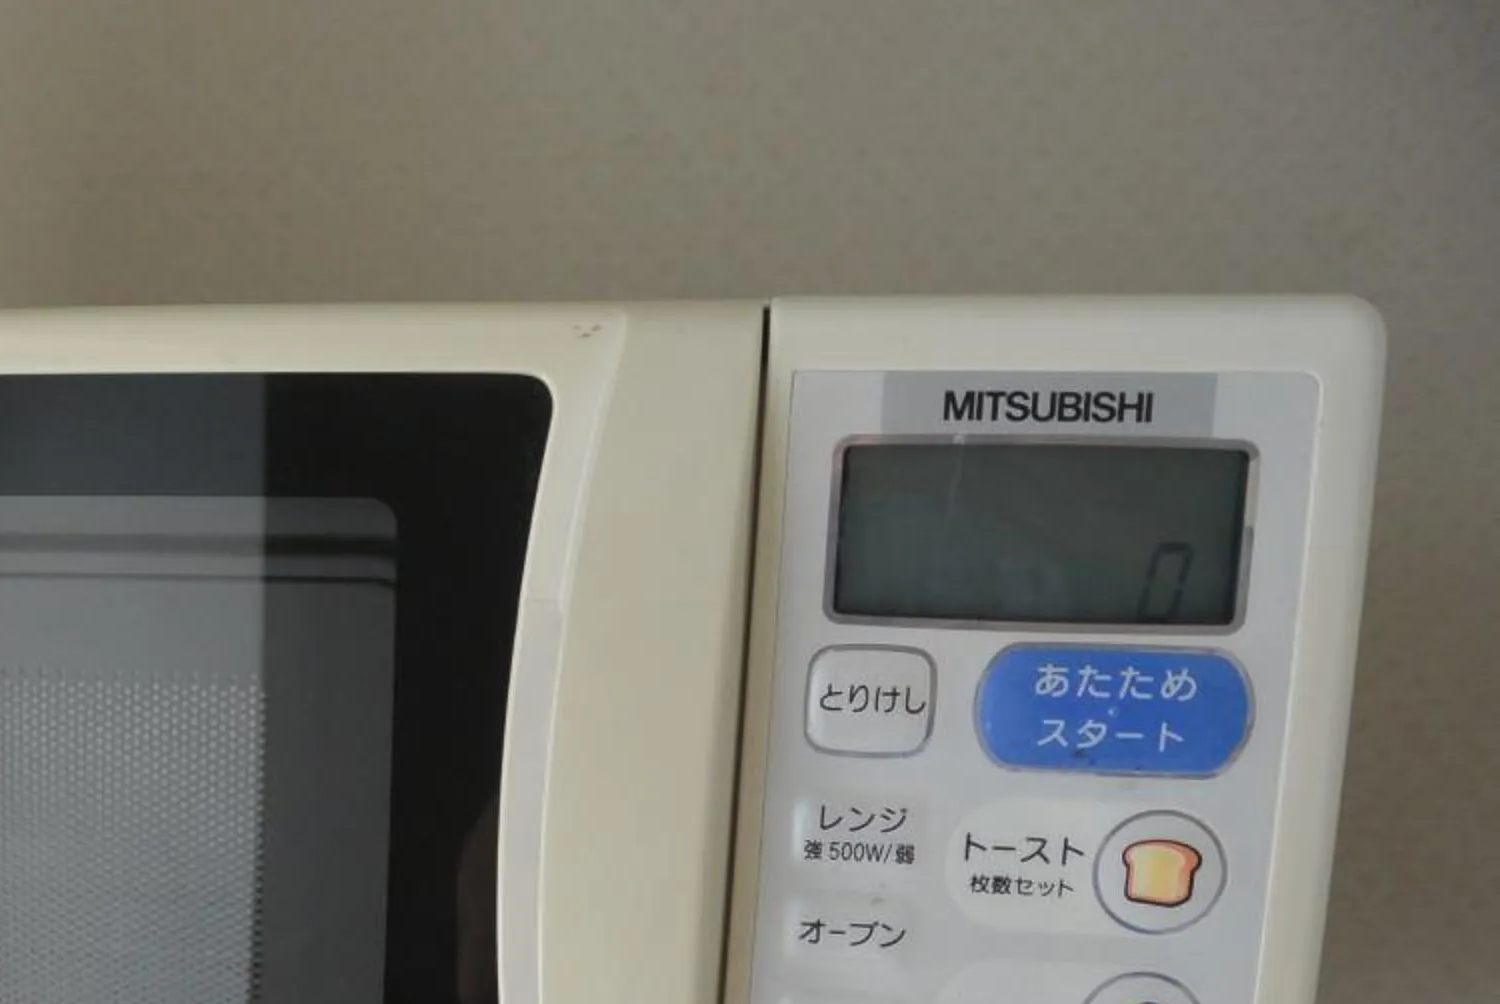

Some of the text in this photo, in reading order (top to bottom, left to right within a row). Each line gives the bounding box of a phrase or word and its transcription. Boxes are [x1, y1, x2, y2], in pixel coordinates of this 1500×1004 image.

[943, 391, 1154, 424] MITSUBISHI
[1035, 663, 1197, 701] あたため
[818, 683, 927, 716] とりけし
[1037, 719, 1184, 752] スタート
[819, 805, 908, 833] レンジ
[964, 832, 1085, 867] トースト
[970, 874, 1075, 898] 枚数セット
[798, 919, 906, 948] オーブン
